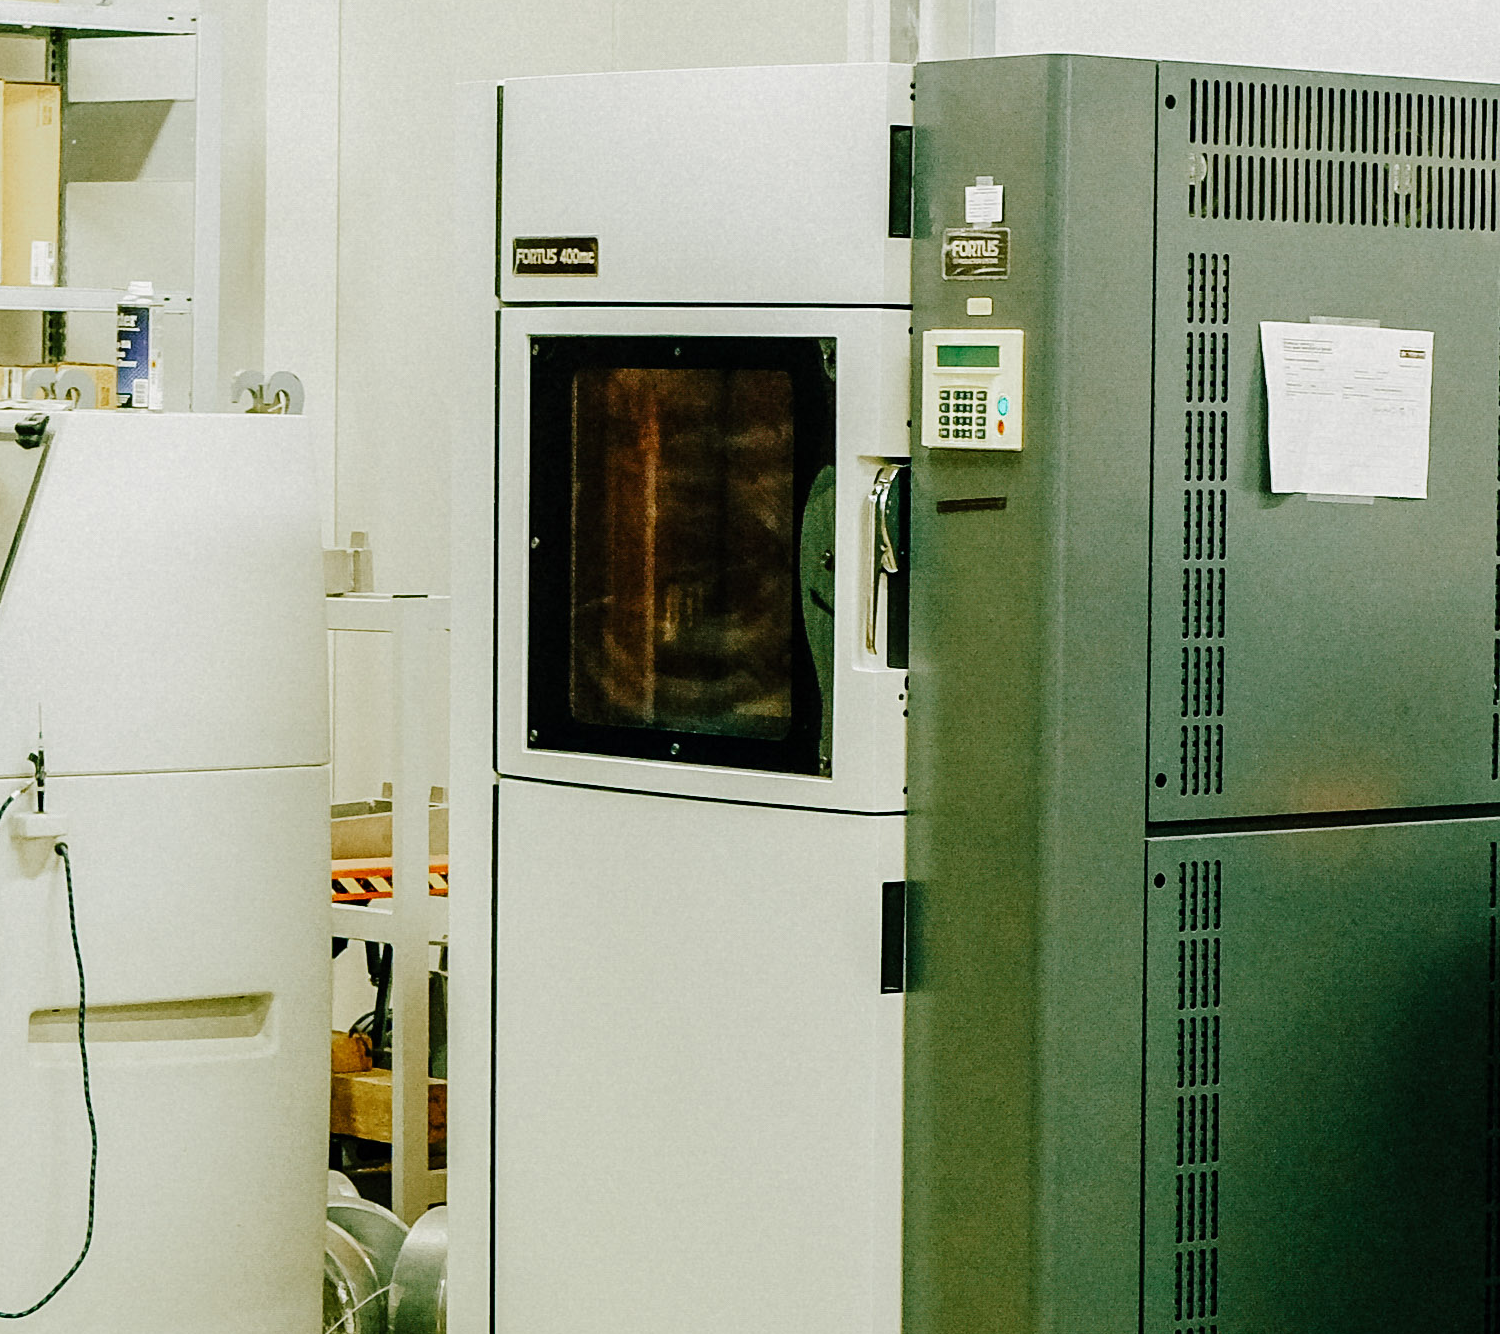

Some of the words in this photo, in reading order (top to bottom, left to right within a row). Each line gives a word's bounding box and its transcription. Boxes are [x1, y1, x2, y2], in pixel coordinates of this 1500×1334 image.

[515, 248, 558, 265] FORTUS
[559, 248, 596, 265] 400mc
[951, 240, 1000, 257] FORTUS
